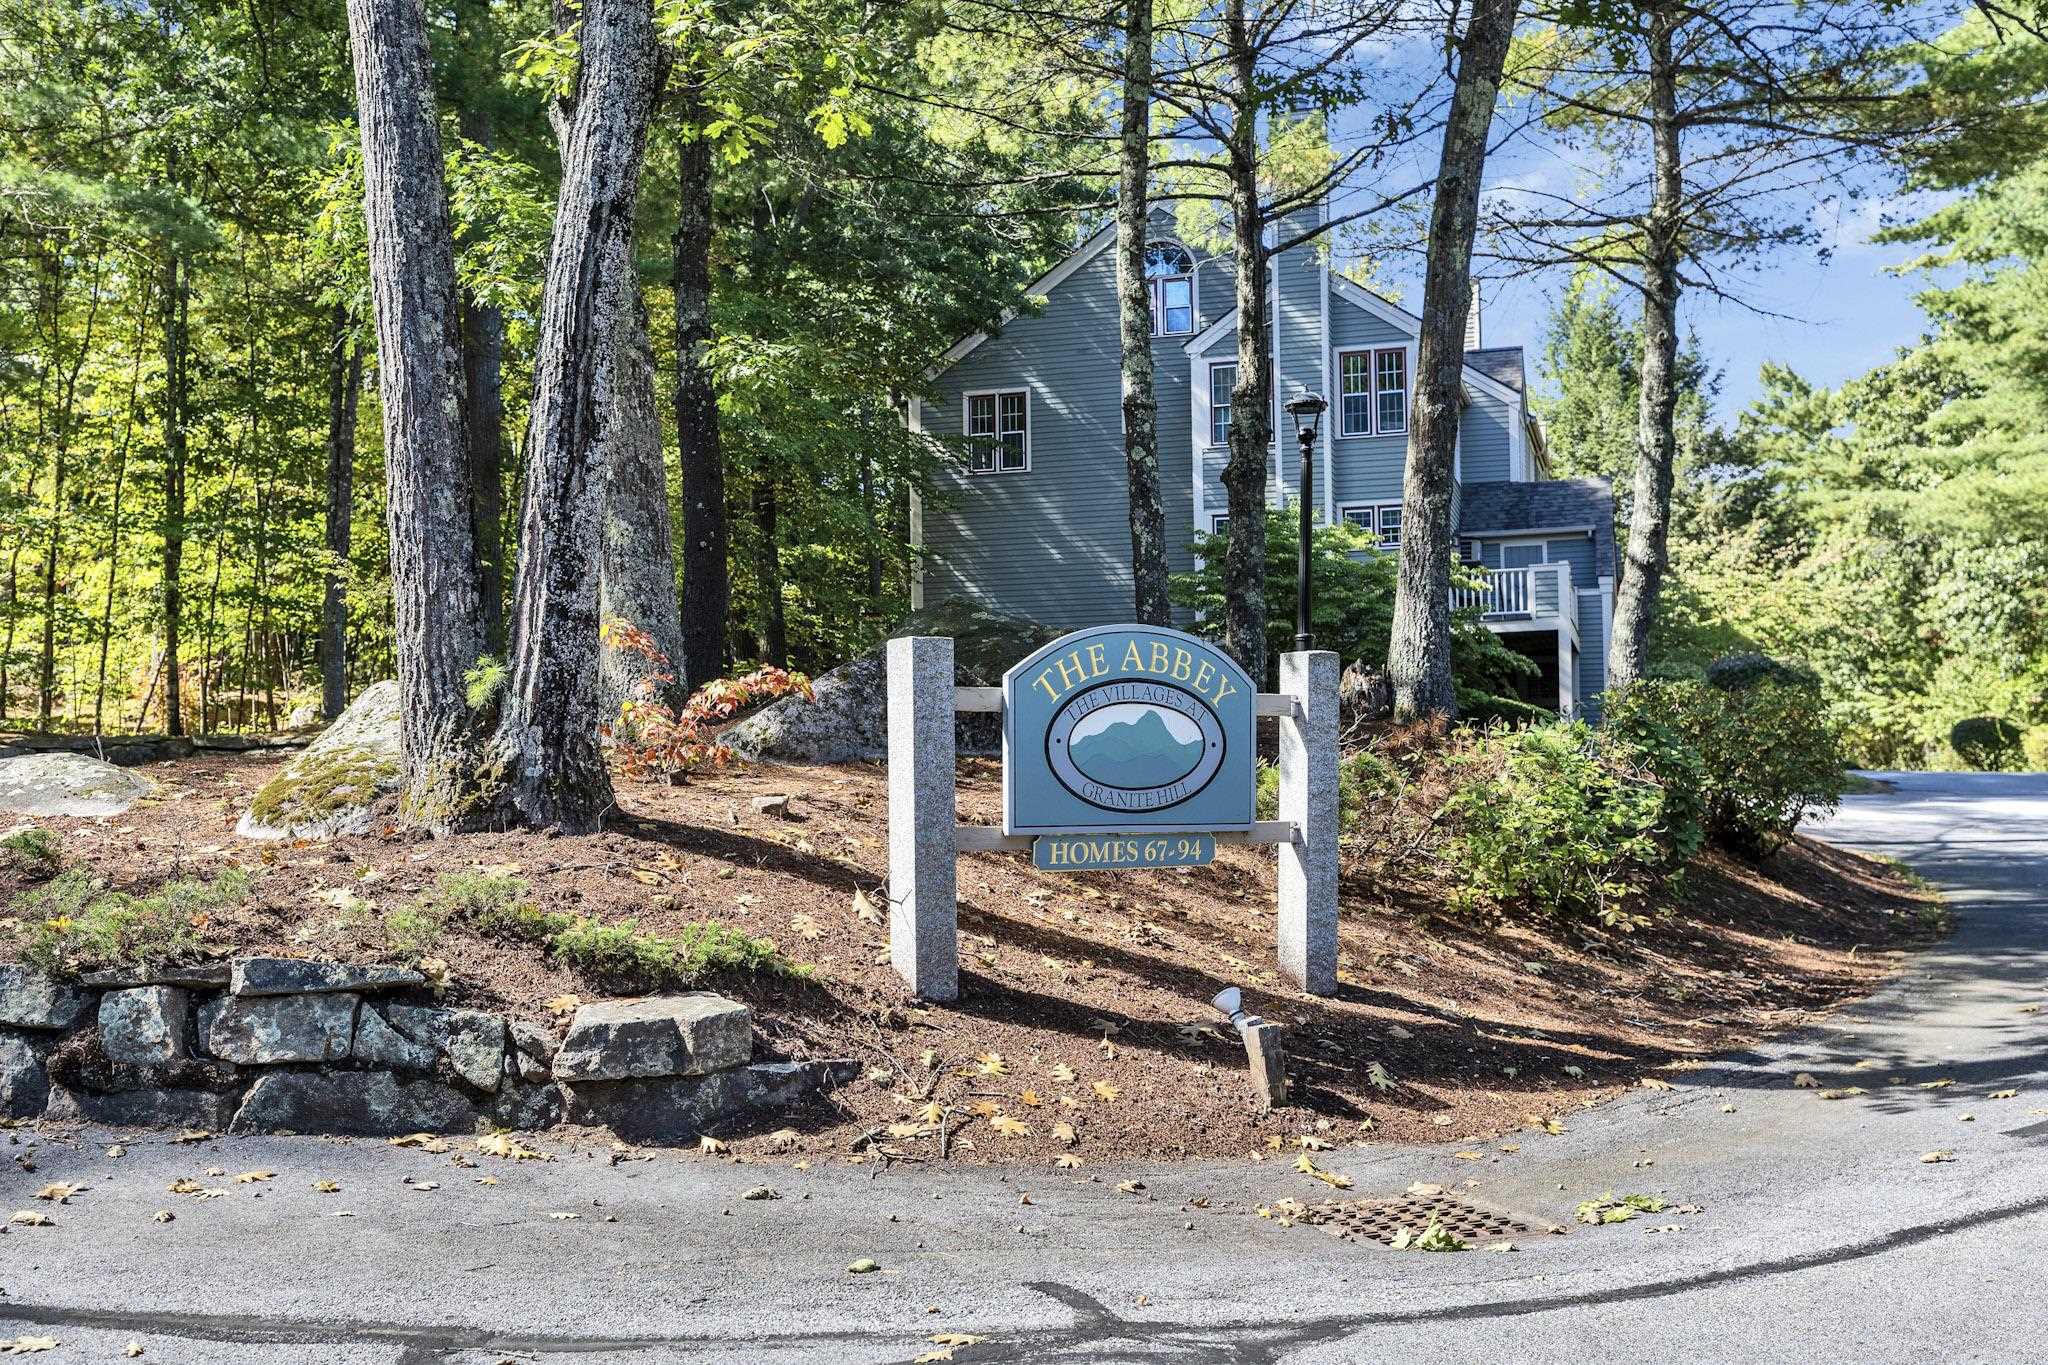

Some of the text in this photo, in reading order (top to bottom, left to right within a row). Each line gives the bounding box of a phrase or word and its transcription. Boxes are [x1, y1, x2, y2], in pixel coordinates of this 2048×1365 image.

[1032, 639, 1238, 708] THE ABBEY
[1064, 684, 1209, 722] THE VILLAGES AT
[1082, 782, 1192, 808] GRANITE HILL
[1049, 839, 1202, 865] HOMES 67-94
